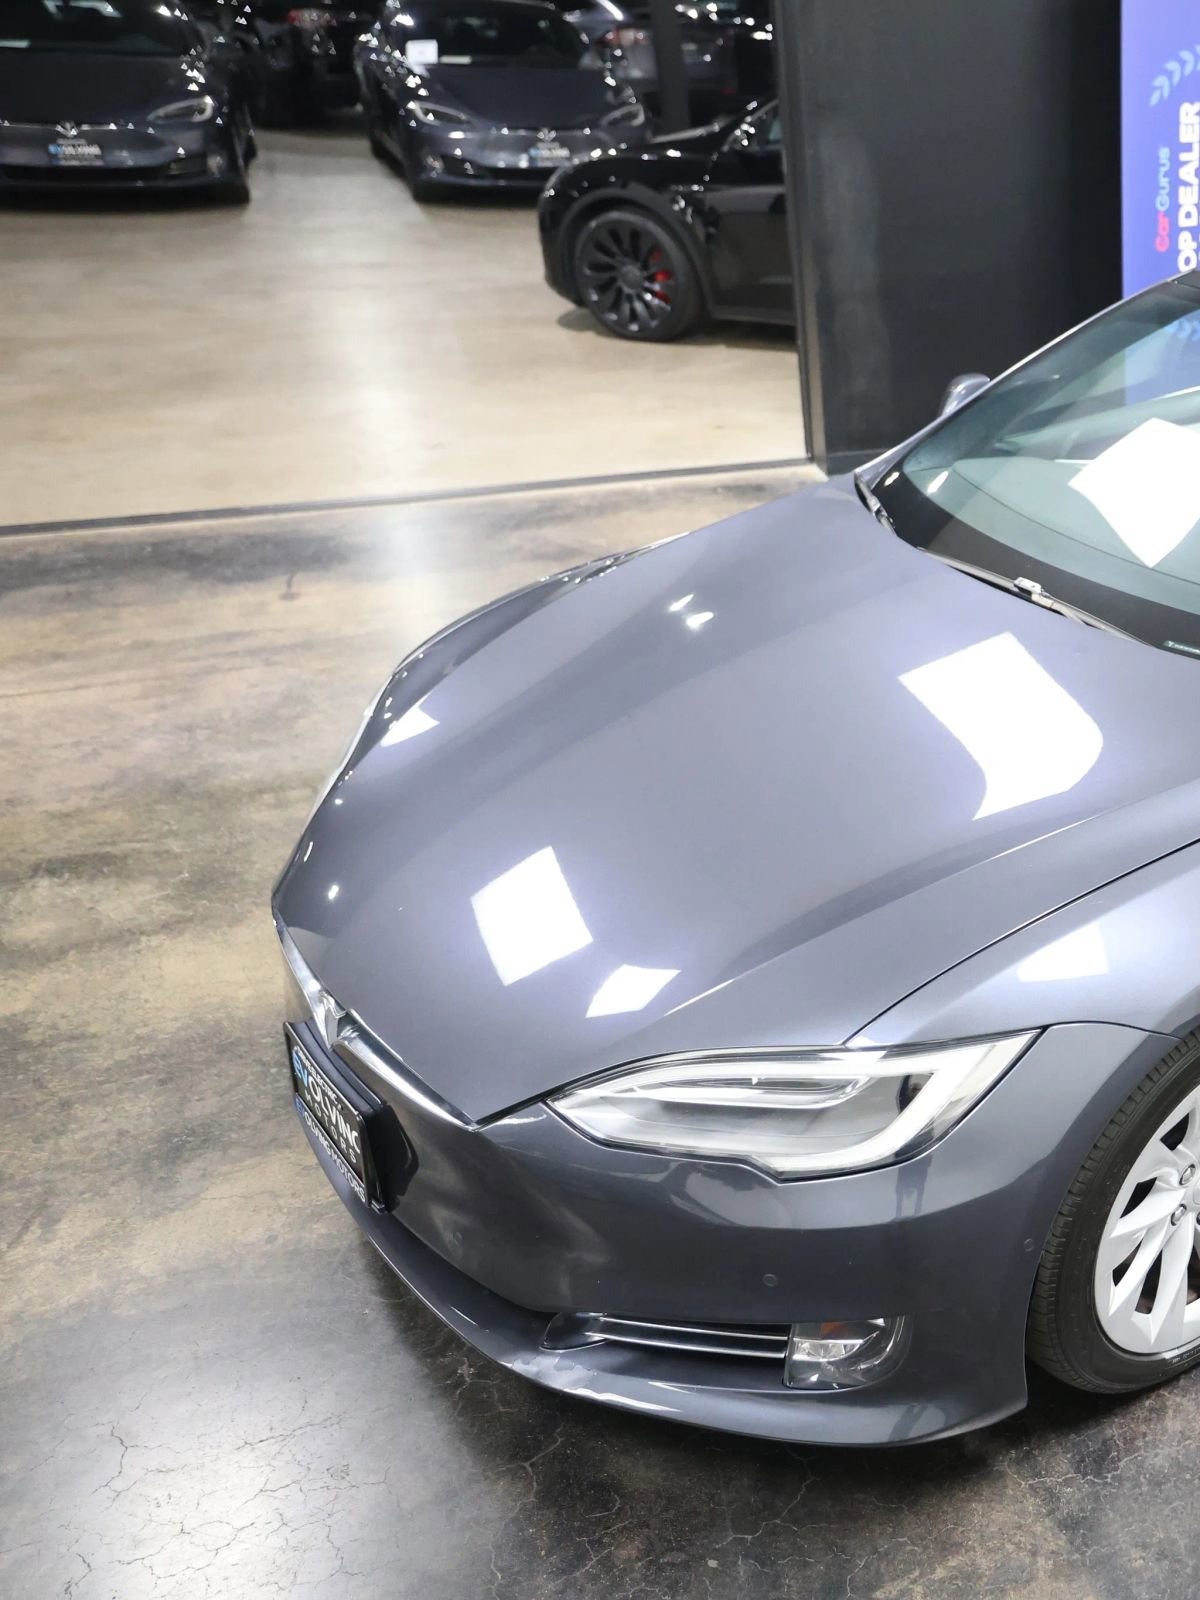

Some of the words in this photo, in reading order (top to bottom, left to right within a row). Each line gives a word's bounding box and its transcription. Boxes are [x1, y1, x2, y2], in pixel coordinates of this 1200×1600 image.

[1154, 146, 1171, 253] CarGurus
[1178, 101, 1200, 228] DEALER
[1177, 231, 1198, 273] OP
[304, 1089, 357, 1164] MOTORS
